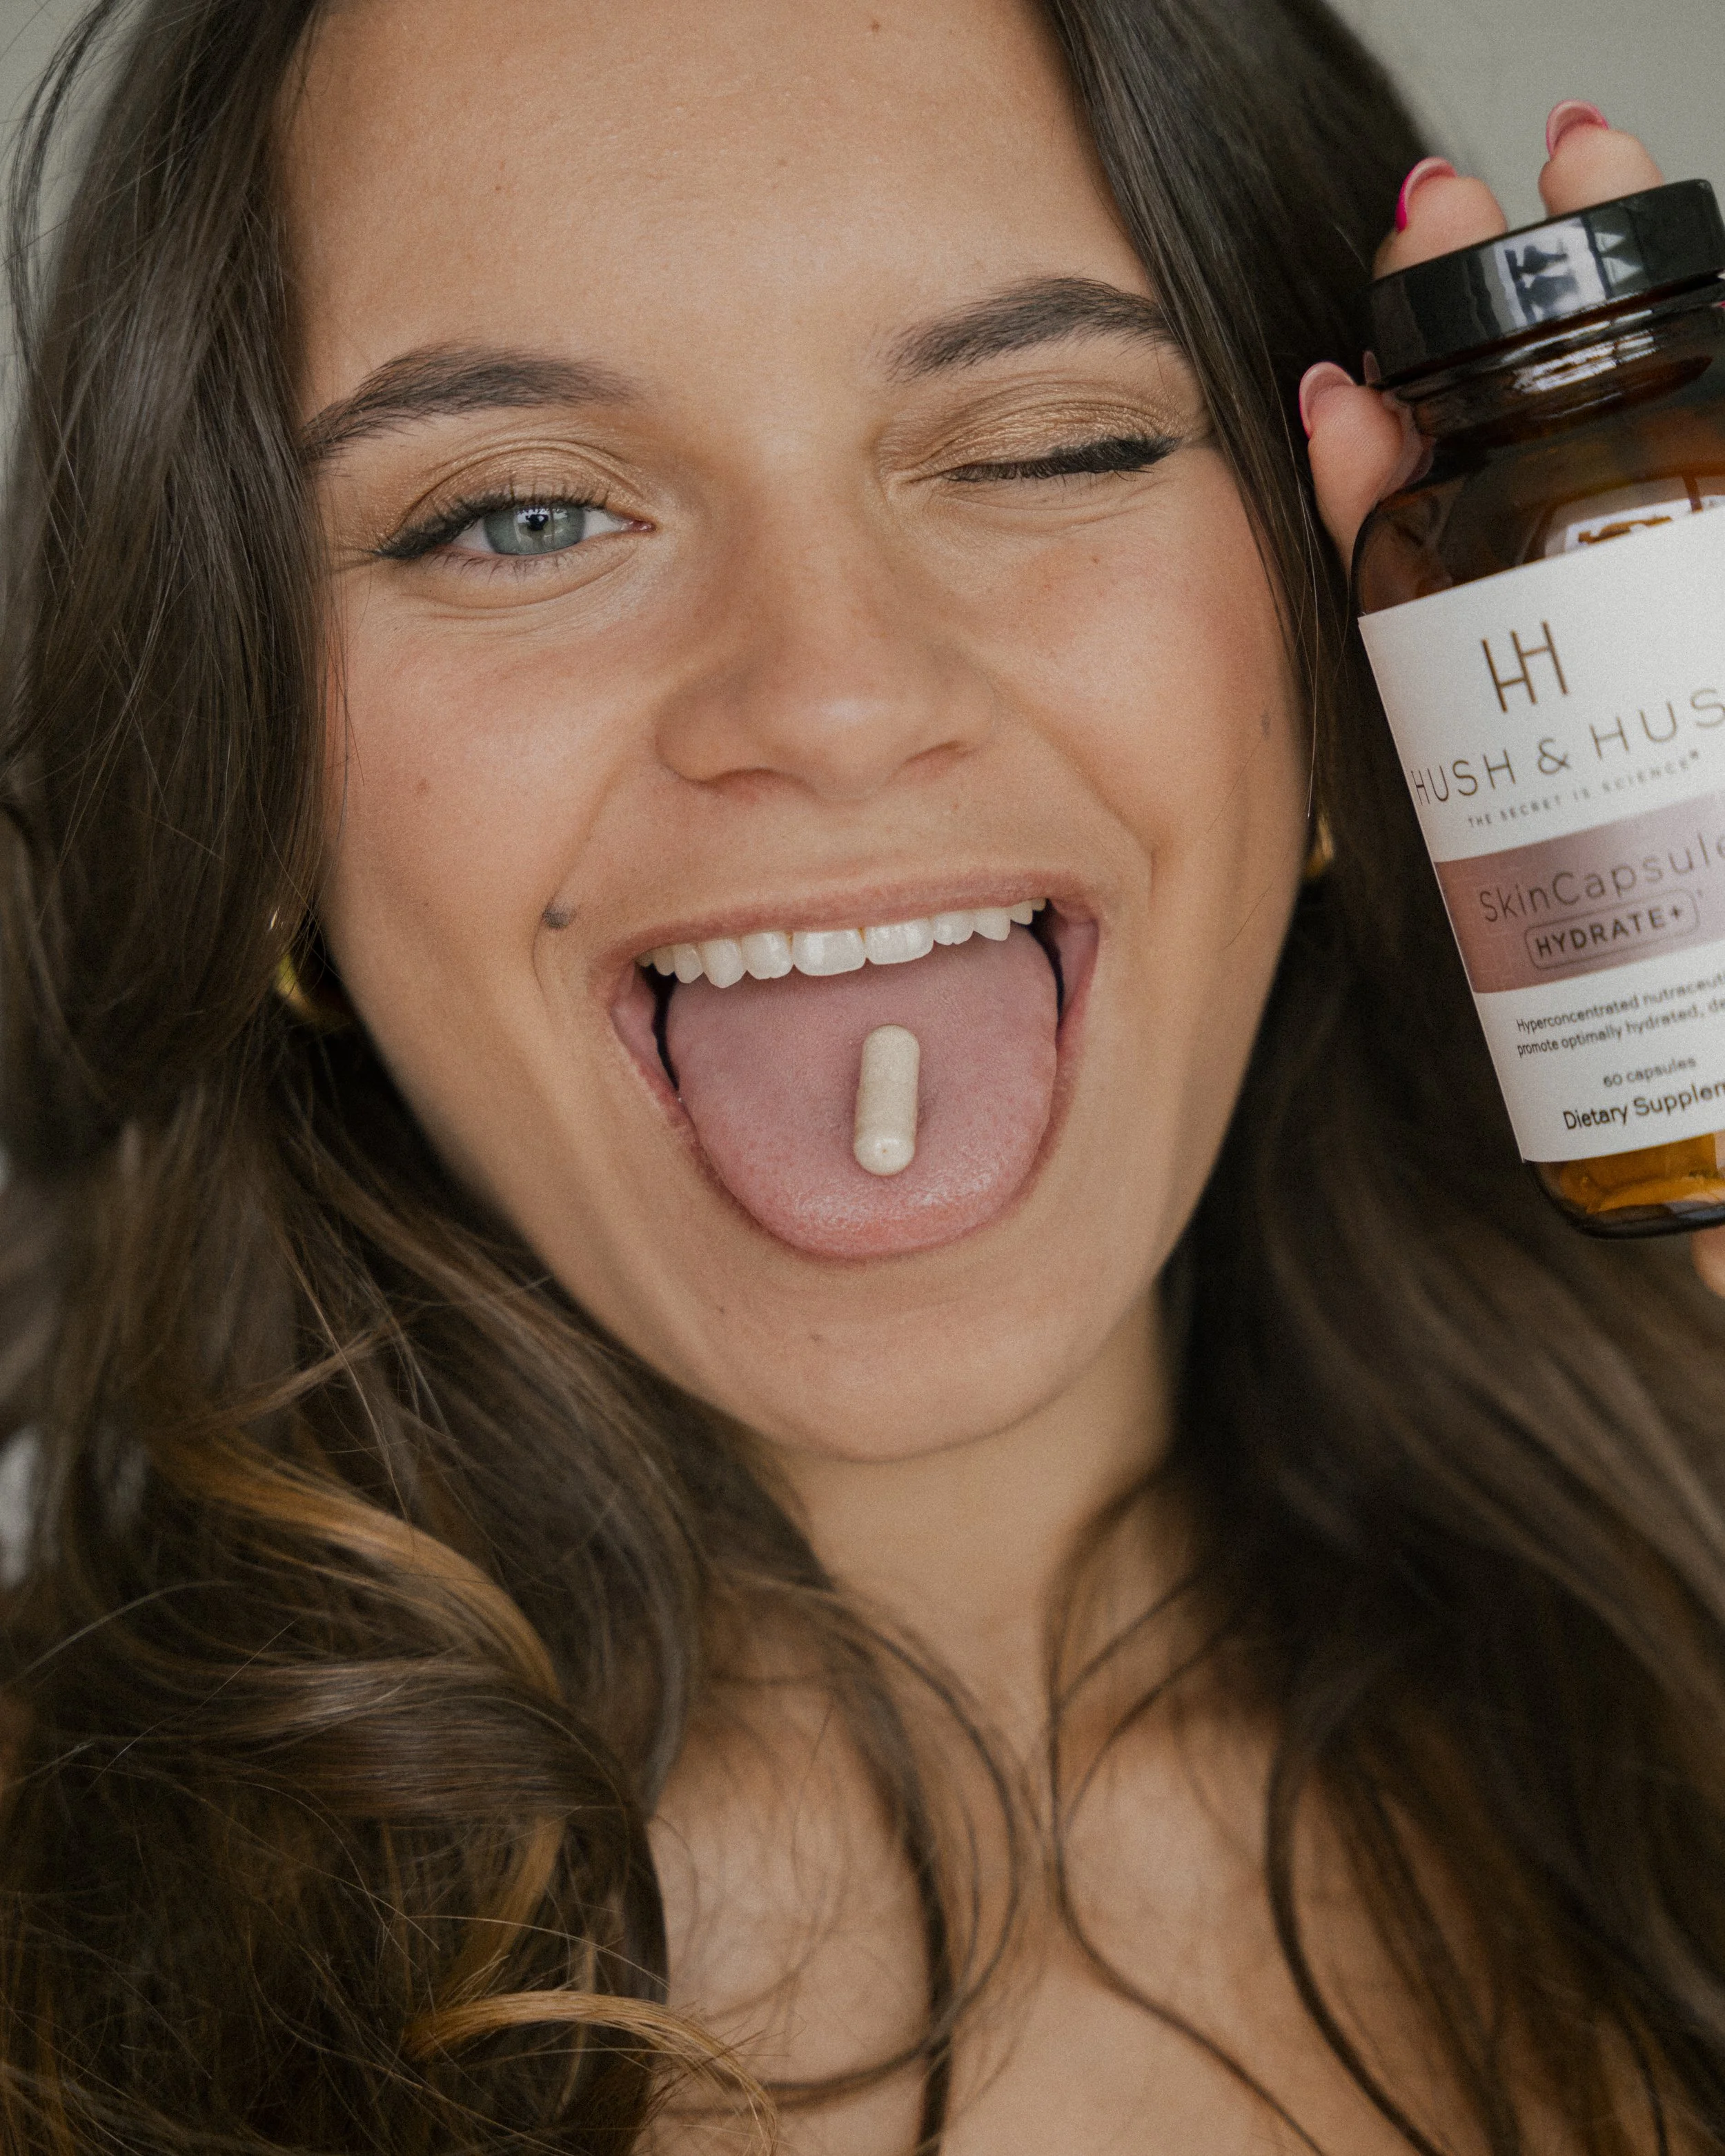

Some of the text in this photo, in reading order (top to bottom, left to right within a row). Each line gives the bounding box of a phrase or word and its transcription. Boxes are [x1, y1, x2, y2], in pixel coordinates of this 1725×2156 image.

[1410, 687, 1725, 807] HUSH & HUS
[1468, 813, 1492, 829] THE
[1499, 793, 1562, 822] SECRET
[1535, 905, 1684, 959] HYDRATE+
[1516, 994, 1640, 1035] Hyperconcentrated
[1517, 1038, 1559, 1058] promote
[1561, 1023, 1622, 1050] optimally
[1603, 1056, 1697, 1089] 60 capsules
[1562, 1102, 1628, 1130] Dietary
